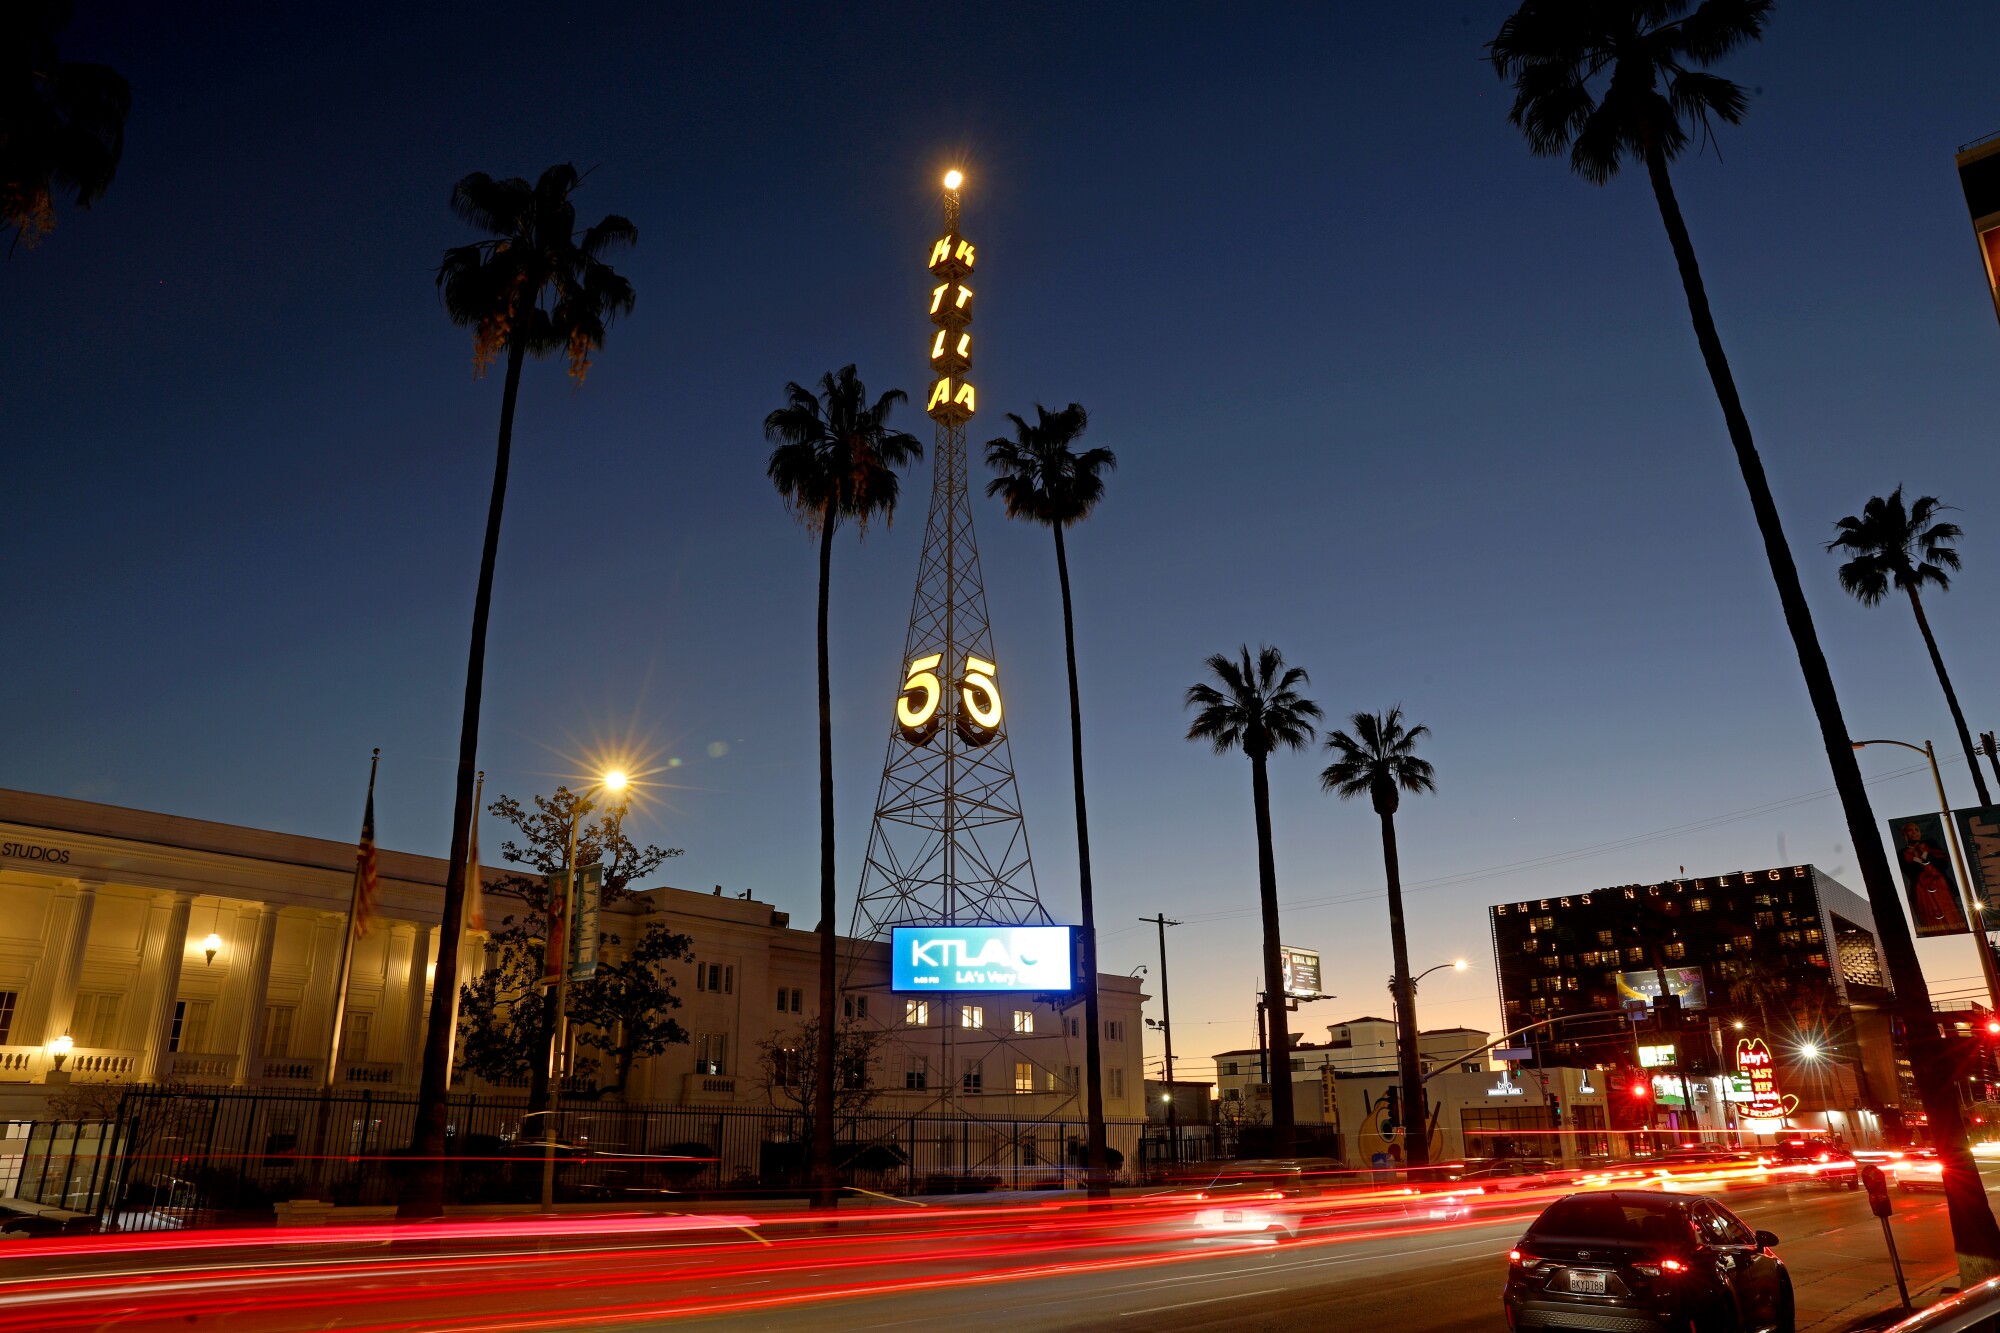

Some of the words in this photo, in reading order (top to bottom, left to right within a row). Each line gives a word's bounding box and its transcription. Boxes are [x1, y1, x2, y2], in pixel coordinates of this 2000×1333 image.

[898, 653, 942, 728] 5
[963, 656, 1002, 728] 5
[1, 842, 70, 864] STUDIOS
[1497, 888, 1635, 916] EMERSN
[1648, 866, 1806, 896] COLLEGE
[912, 939, 1010, 967] KTLA
[1740, 1052, 1768, 1065] Arby's
